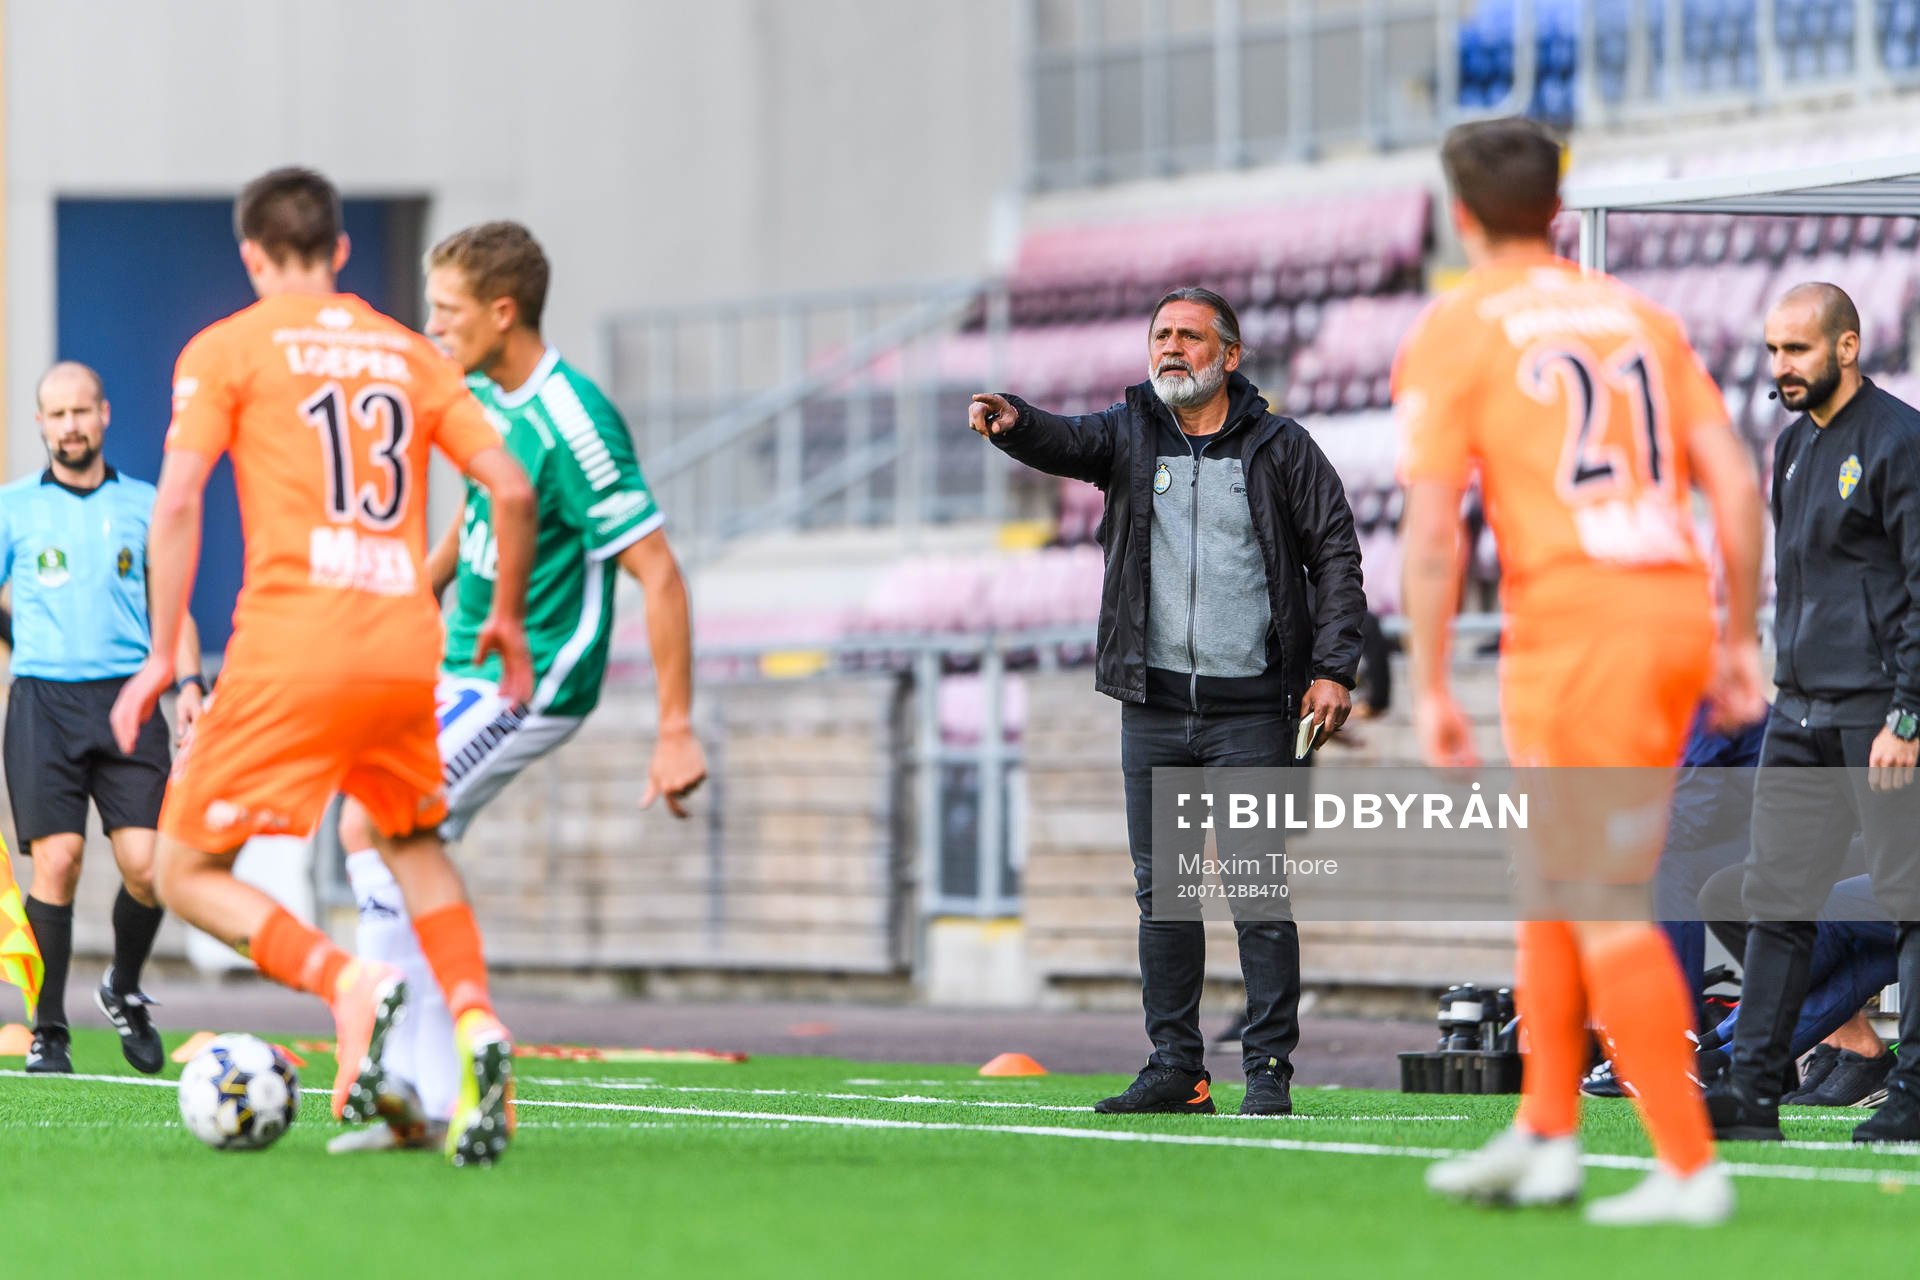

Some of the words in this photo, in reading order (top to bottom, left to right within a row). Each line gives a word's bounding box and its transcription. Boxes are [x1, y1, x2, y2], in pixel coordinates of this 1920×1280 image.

[285, 343, 413, 384] LOEPER
[1523, 344, 1671, 497] 21
[299, 384, 412, 528] 13
